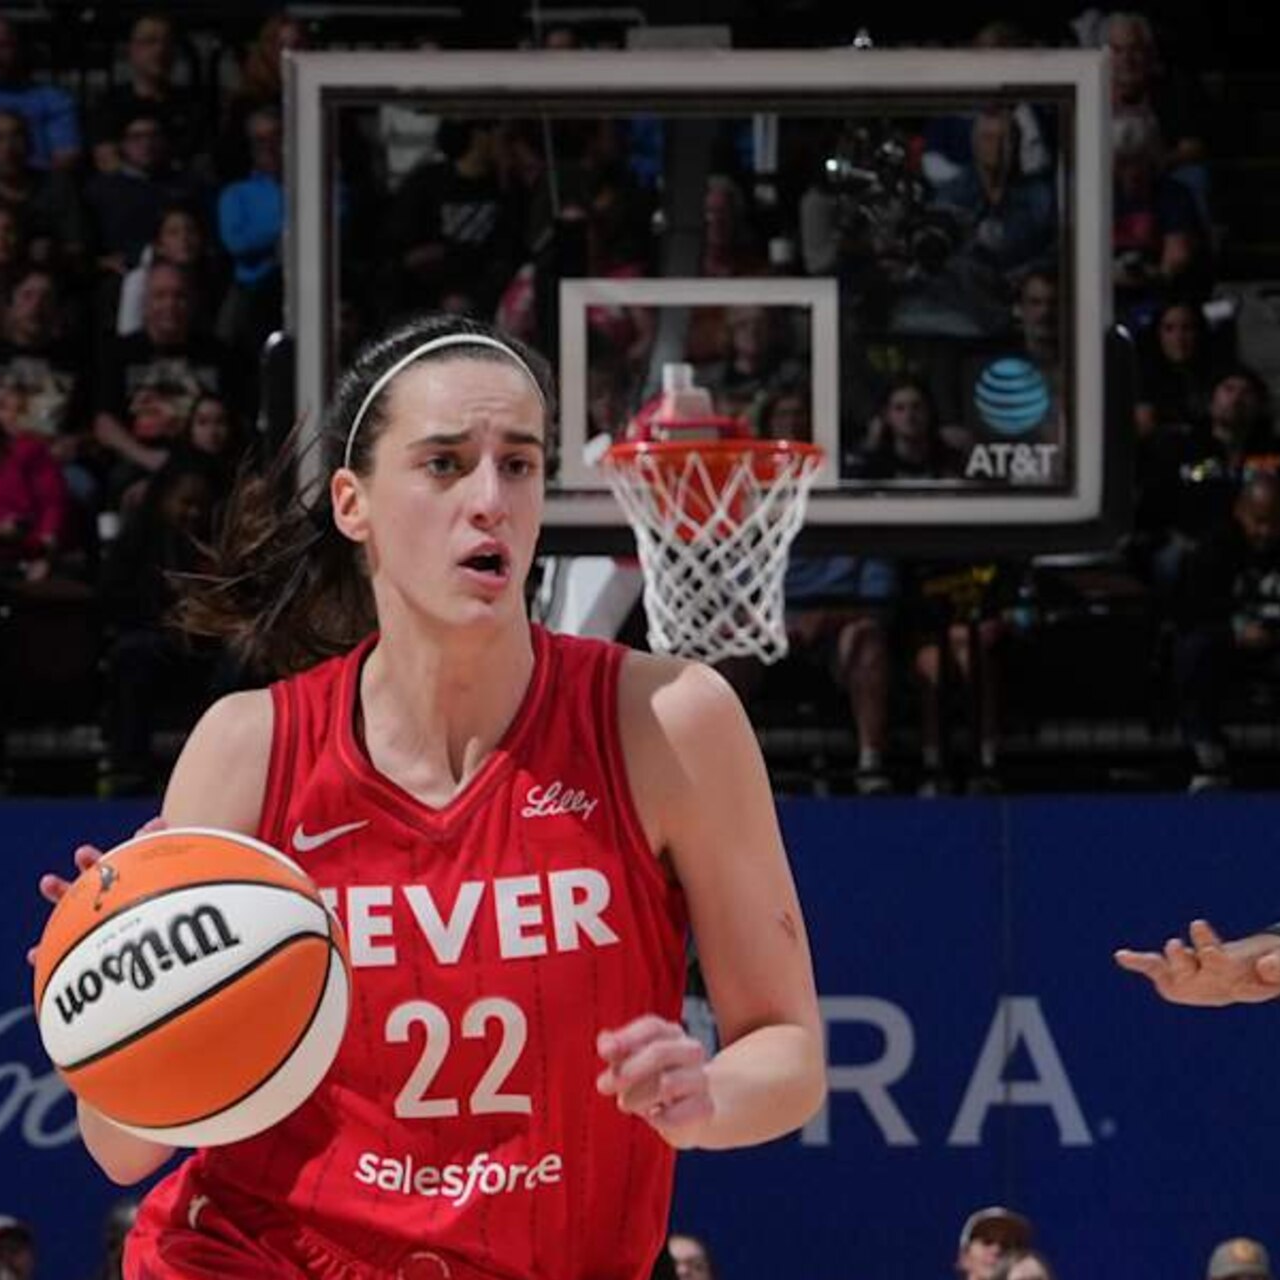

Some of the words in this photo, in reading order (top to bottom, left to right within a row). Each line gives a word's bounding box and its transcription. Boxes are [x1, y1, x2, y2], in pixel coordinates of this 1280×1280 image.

[965, 442, 1059, 480] AT&T
[520, 781, 597, 820] Lilly
[320, 867, 621, 968] EVER
[54, 903, 241, 1025] Wilson
[384, 997, 533, 1119] 22
[354, 1151, 564, 1207] salesforce
